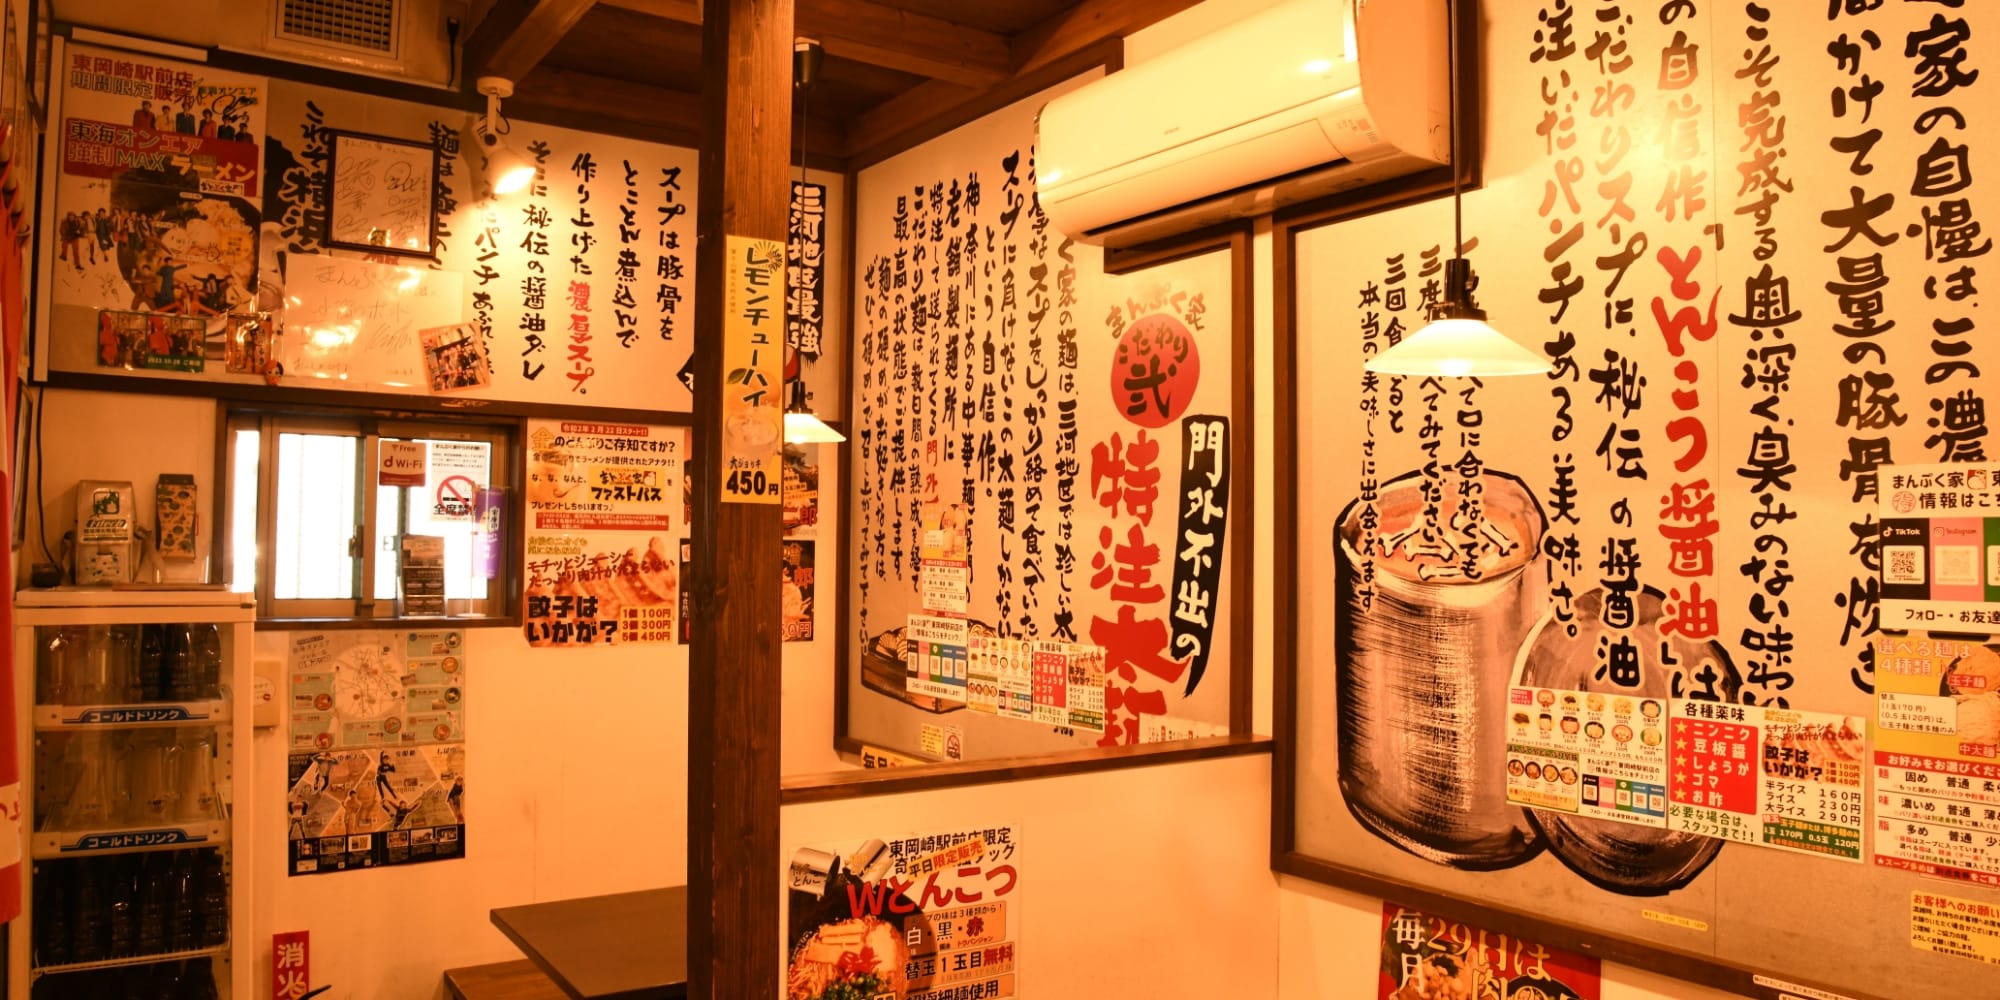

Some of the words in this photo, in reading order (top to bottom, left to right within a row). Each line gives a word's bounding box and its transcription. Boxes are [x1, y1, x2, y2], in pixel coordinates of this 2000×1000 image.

[72, 53, 194, 89] 東岡崎駅前店
[70, 71, 196, 103] 期間限定販売
[69, 120, 204, 155] 東海オンエア
[67, 141, 255, 182] 強制MAXラーメン
[612, 159, 642, 349] とことん煮込んで
[656, 166, 687, 341] スープは豚骨を
[566, 152, 598, 395] 作り上げた濃厚スープ。
[787, 184, 825, 358] 三河地区最強
[941, 178, 963, 462] 老舗製麺所に
[1105, 281, 1206, 339] まんぷく家
[743, 246, 770, 408] レモンチューハイ
[1117, 320, 1189, 365] こだわり
[977, 225, 999, 497] という自信作。
[1122, 354, 1178, 420] 弐
[1417, 244, 1447, 544] 三度べてみてください
[399, 445, 417, 453] Free
[395, 459, 423, 469] Wi-Fi
[725, 470, 779, 497] 450円
[1892, 471, 1964, 490] まんぷく家
[591, 486, 662, 502] ファストパス
[1919, 493, 2000, 510] 情報はこ
[1175, 420, 1226, 659] 門外不出の
[1895, 527, 1921, 536] TikTok
[527, 595, 599, 619] 餃子は
[623, 608, 638, 618] 1個
[641, 608, 671, 618] 100円
[527, 620, 618, 643] いかが?
[622, 619, 638, 630] 3個
[641, 619, 671, 630] 300円
[622, 631, 638, 642] 5個
[641, 631, 671, 643] 450円
[1878, 638, 1972, 658] 選べる麺は
[1042, 655, 1065, 666] ニンニク
[1949, 675, 1986, 689] 玉子麺
[89, 709, 181, 723] コールドドリンク
[1685, 703, 1745, 722] 各種薬味
[1693, 722, 1751, 742] ニンニク
[1693, 738, 1747, 760] 豆板醤
[1765, 745, 1810, 764] 餃子は
[1959, 743, 1996, 758] 中太麺
[1693, 756, 1750, 777] しょうが
[1764, 761, 1823, 782] いかが?
[1692, 775, 1719, 788] ゴマ
[1765, 780, 1806, 795] 半ライス
[1819, 788, 1861, 804] 160円
[1905, 771, 1929, 784] 固め
[1946, 776, 1970, 790] 普通
[1692, 790, 1724, 808] お酢
[1765, 791, 1795, 804] ライス
[1819, 800, 1861, 815] 230円
[1901, 798, 1936, 812] 濃いめ
[1947, 804, 1971, 818] 普通
[1669, 804, 1749, 829] 必要な場合は、
[1765, 802, 1806, 818] 大ライス
[1819, 811, 1861, 827] 290円
[86, 830, 180, 848] コールドドリンク
[1779, 829, 1803, 840] 170円
[1834, 839, 1860, 851] 120円
[1906, 823, 1929, 837] 多め
[1949, 830, 1972, 844] 普通
[909, 842, 984, 878] 平日限定販売
[846, 863, 1019, 920] Wとんこつ
[1913, 894, 2000, 919] お客様へのお願い
[1392, 908, 1426, 993] 毎月
[1426, 916, 1552, 982] 29日は
[277, 942, 304, 997] 消火
[905, 943, 1013, 981] 替玉1玉目無料
